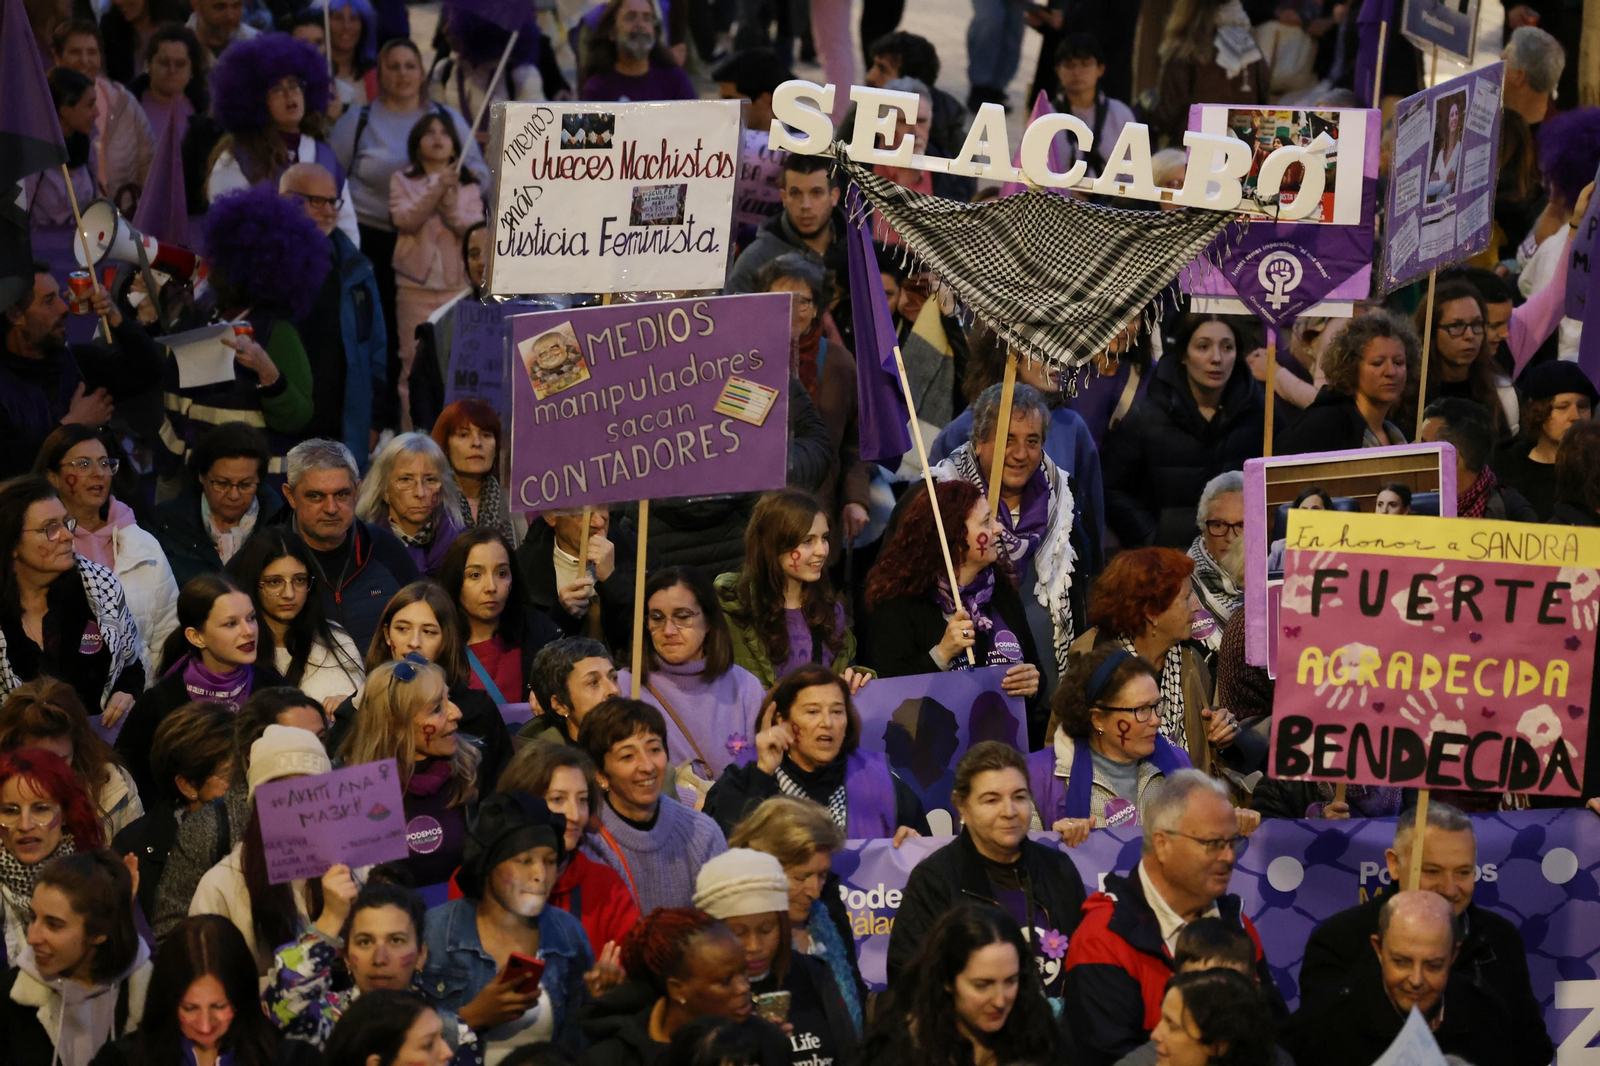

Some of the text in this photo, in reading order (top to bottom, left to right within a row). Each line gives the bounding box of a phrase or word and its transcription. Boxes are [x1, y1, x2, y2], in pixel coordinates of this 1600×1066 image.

[504, 106, 555, 167] menos
[532, 136, 735, 181] Jueces Machistas
[768, 79, 920, 168] SE
[949, 101, 1336, 221] ACABÓ
[500, 185, 543, 231] más
[497, 214, 719, 257] Justicia Feminista.
[586, 301, 715, 366] MEDIOS
[534, 349, 764, 426] manipuladores
[606, 403, 696, 443] sacan
[519, 419, 741, 508] CONTADORES
[1288, 524, 1579, 562] En honor a SANDRA
[1311, 568, 1571, 625] FUERTE
[1296, 646, 1570, 698] AGRADECIDA
[1275, 714, 1582, 792] BENDECIDA
[338, 776, 374, 798] ANA
[406, 827, 443, 841] PODEMOS
[1106, 803, 1136, 826] PODEMOS
[790, 1032, 821, 1052] Life
